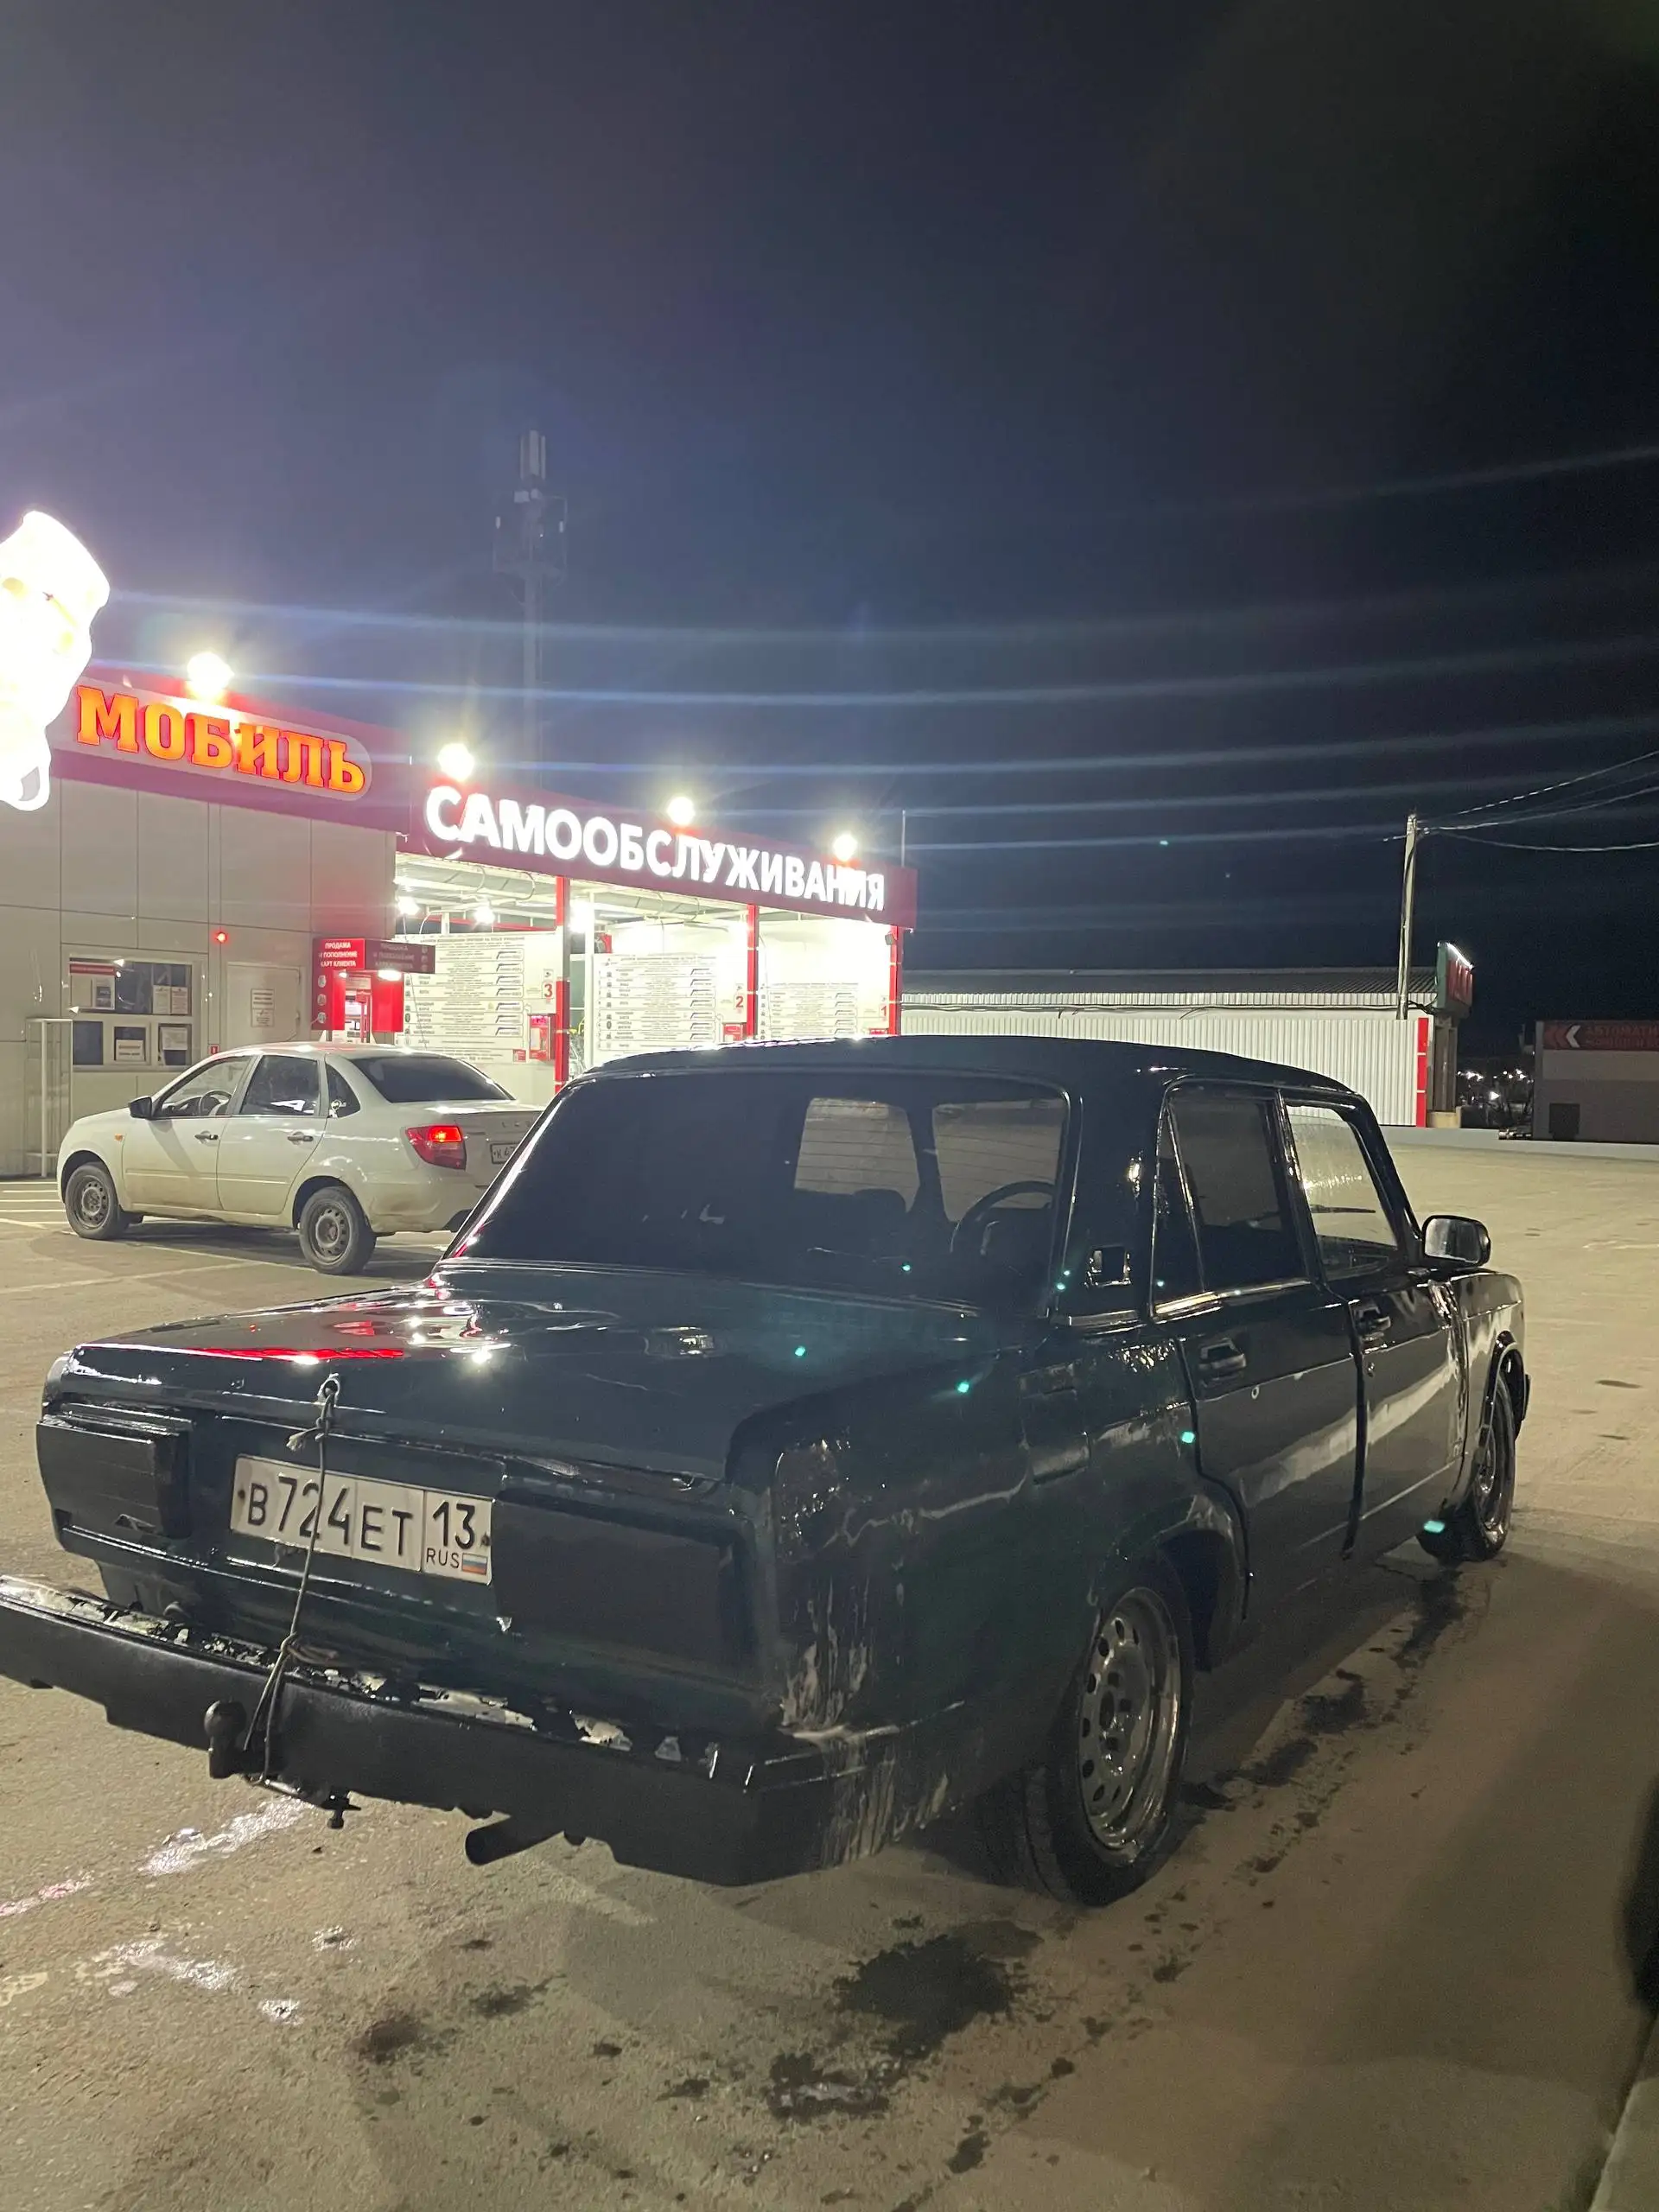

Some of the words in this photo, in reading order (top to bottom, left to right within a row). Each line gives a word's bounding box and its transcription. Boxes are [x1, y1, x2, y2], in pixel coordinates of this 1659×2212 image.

[76, 684, 365, 794] МОБИЛЬ
[425, 785, 885, 912] САМООБСЛУЖИВАНИЯ
[543, 983, 553, 998] 3
[735, 995, 744, 1008] 2
[880, 1005, 887, 1017] 1
[247, 1474, 413, 1556] В724ЕТ
[433, 1501, 475, 1549] 13
[426, 1548, 460, 1569] RUS
